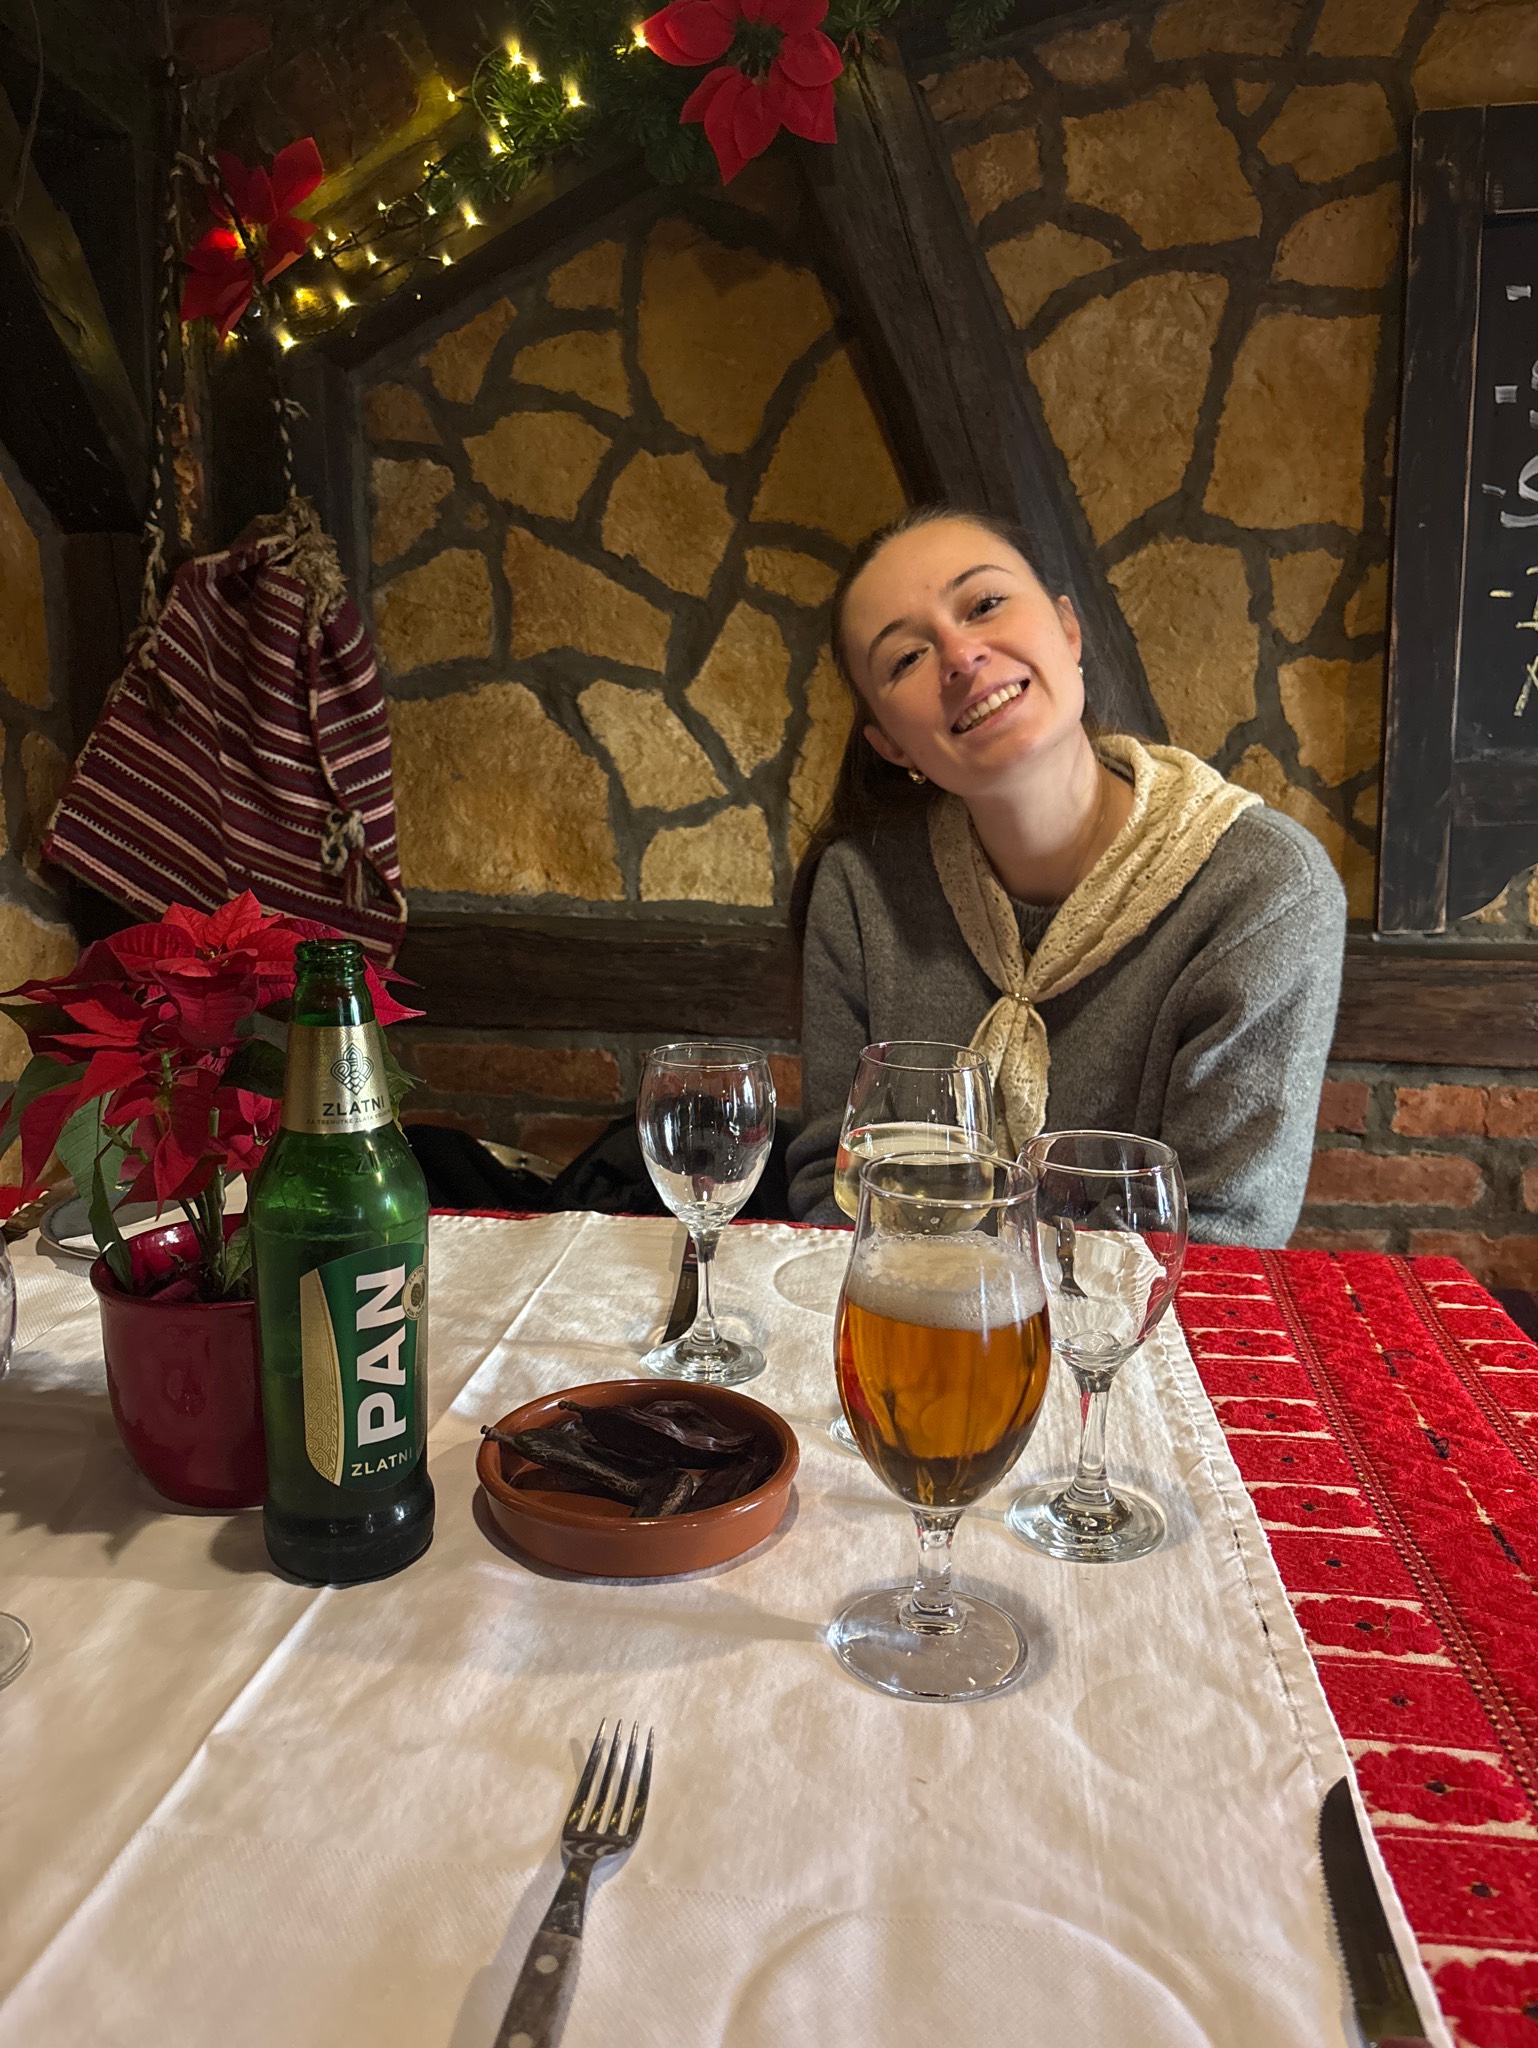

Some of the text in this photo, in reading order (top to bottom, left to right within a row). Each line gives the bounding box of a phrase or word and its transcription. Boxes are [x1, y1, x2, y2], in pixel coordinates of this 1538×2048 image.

[322, 1095, 385, 1116] ZLATNI
[354, 1115, 374, 1123] ZLATA
[356, 1262, 406, 1448] PAN
[351, 1446, 413, 1477] ZLATNI
